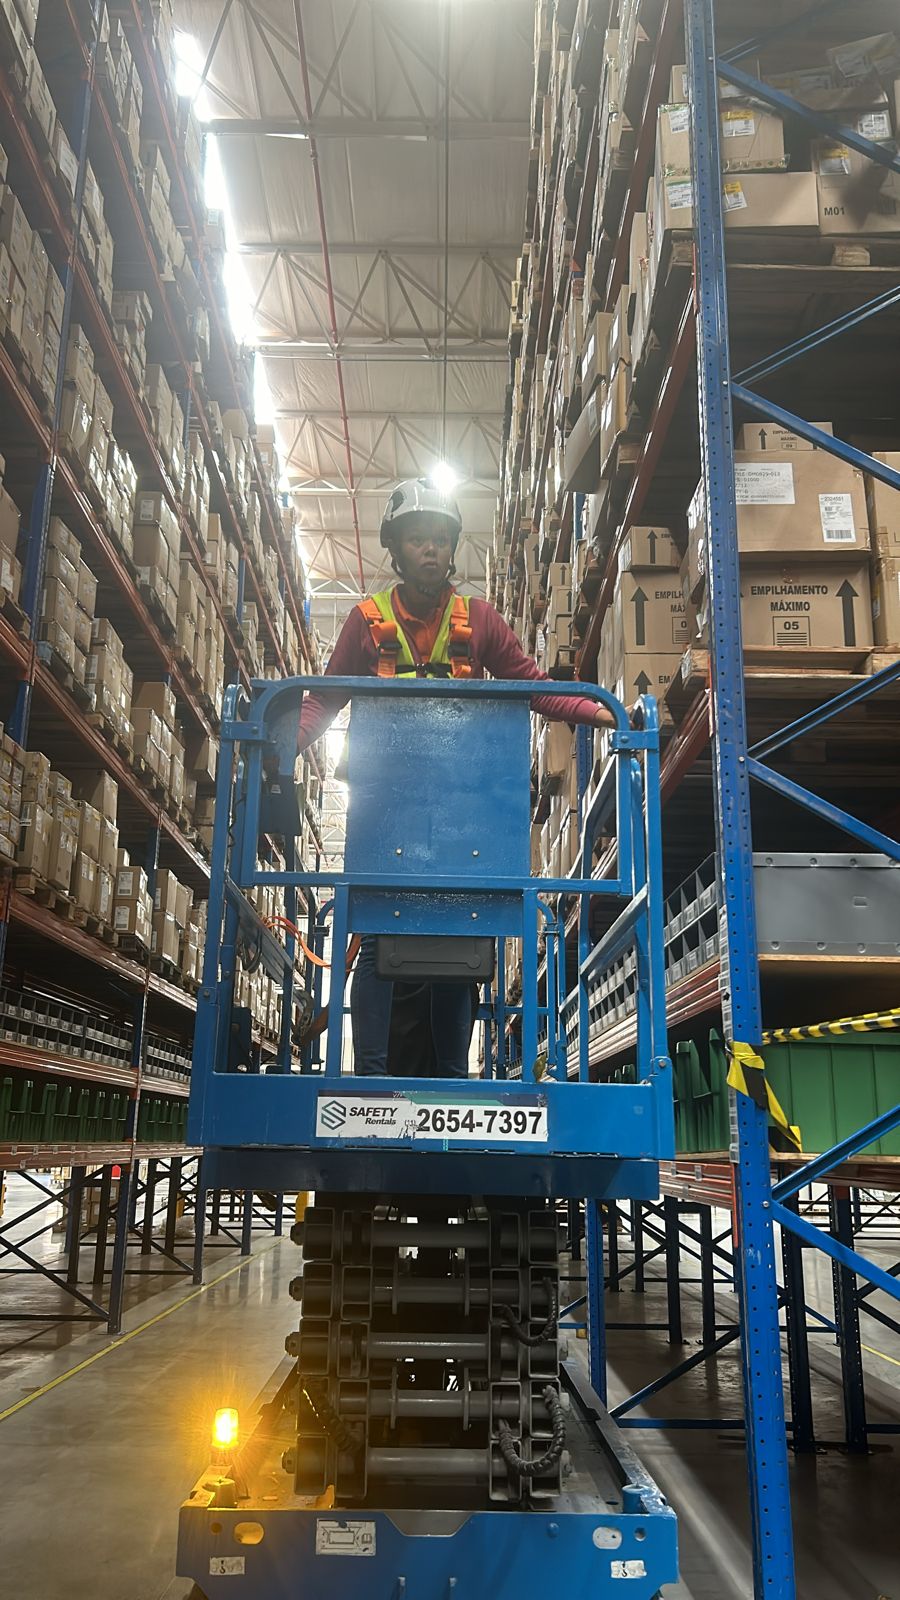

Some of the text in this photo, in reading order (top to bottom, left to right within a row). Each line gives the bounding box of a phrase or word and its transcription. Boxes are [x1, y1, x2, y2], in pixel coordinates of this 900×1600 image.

[824, 207, 845, 216] M01
[752, 586, 828, 596] EMPILHAMENTO
[770, 600, 810, 611] MÁXIMO
[784, 622, 800, 630] 05
[349, 1107, 398, 1117] SAFETY
[416, 1108, 542, 1134] 2654-7397
